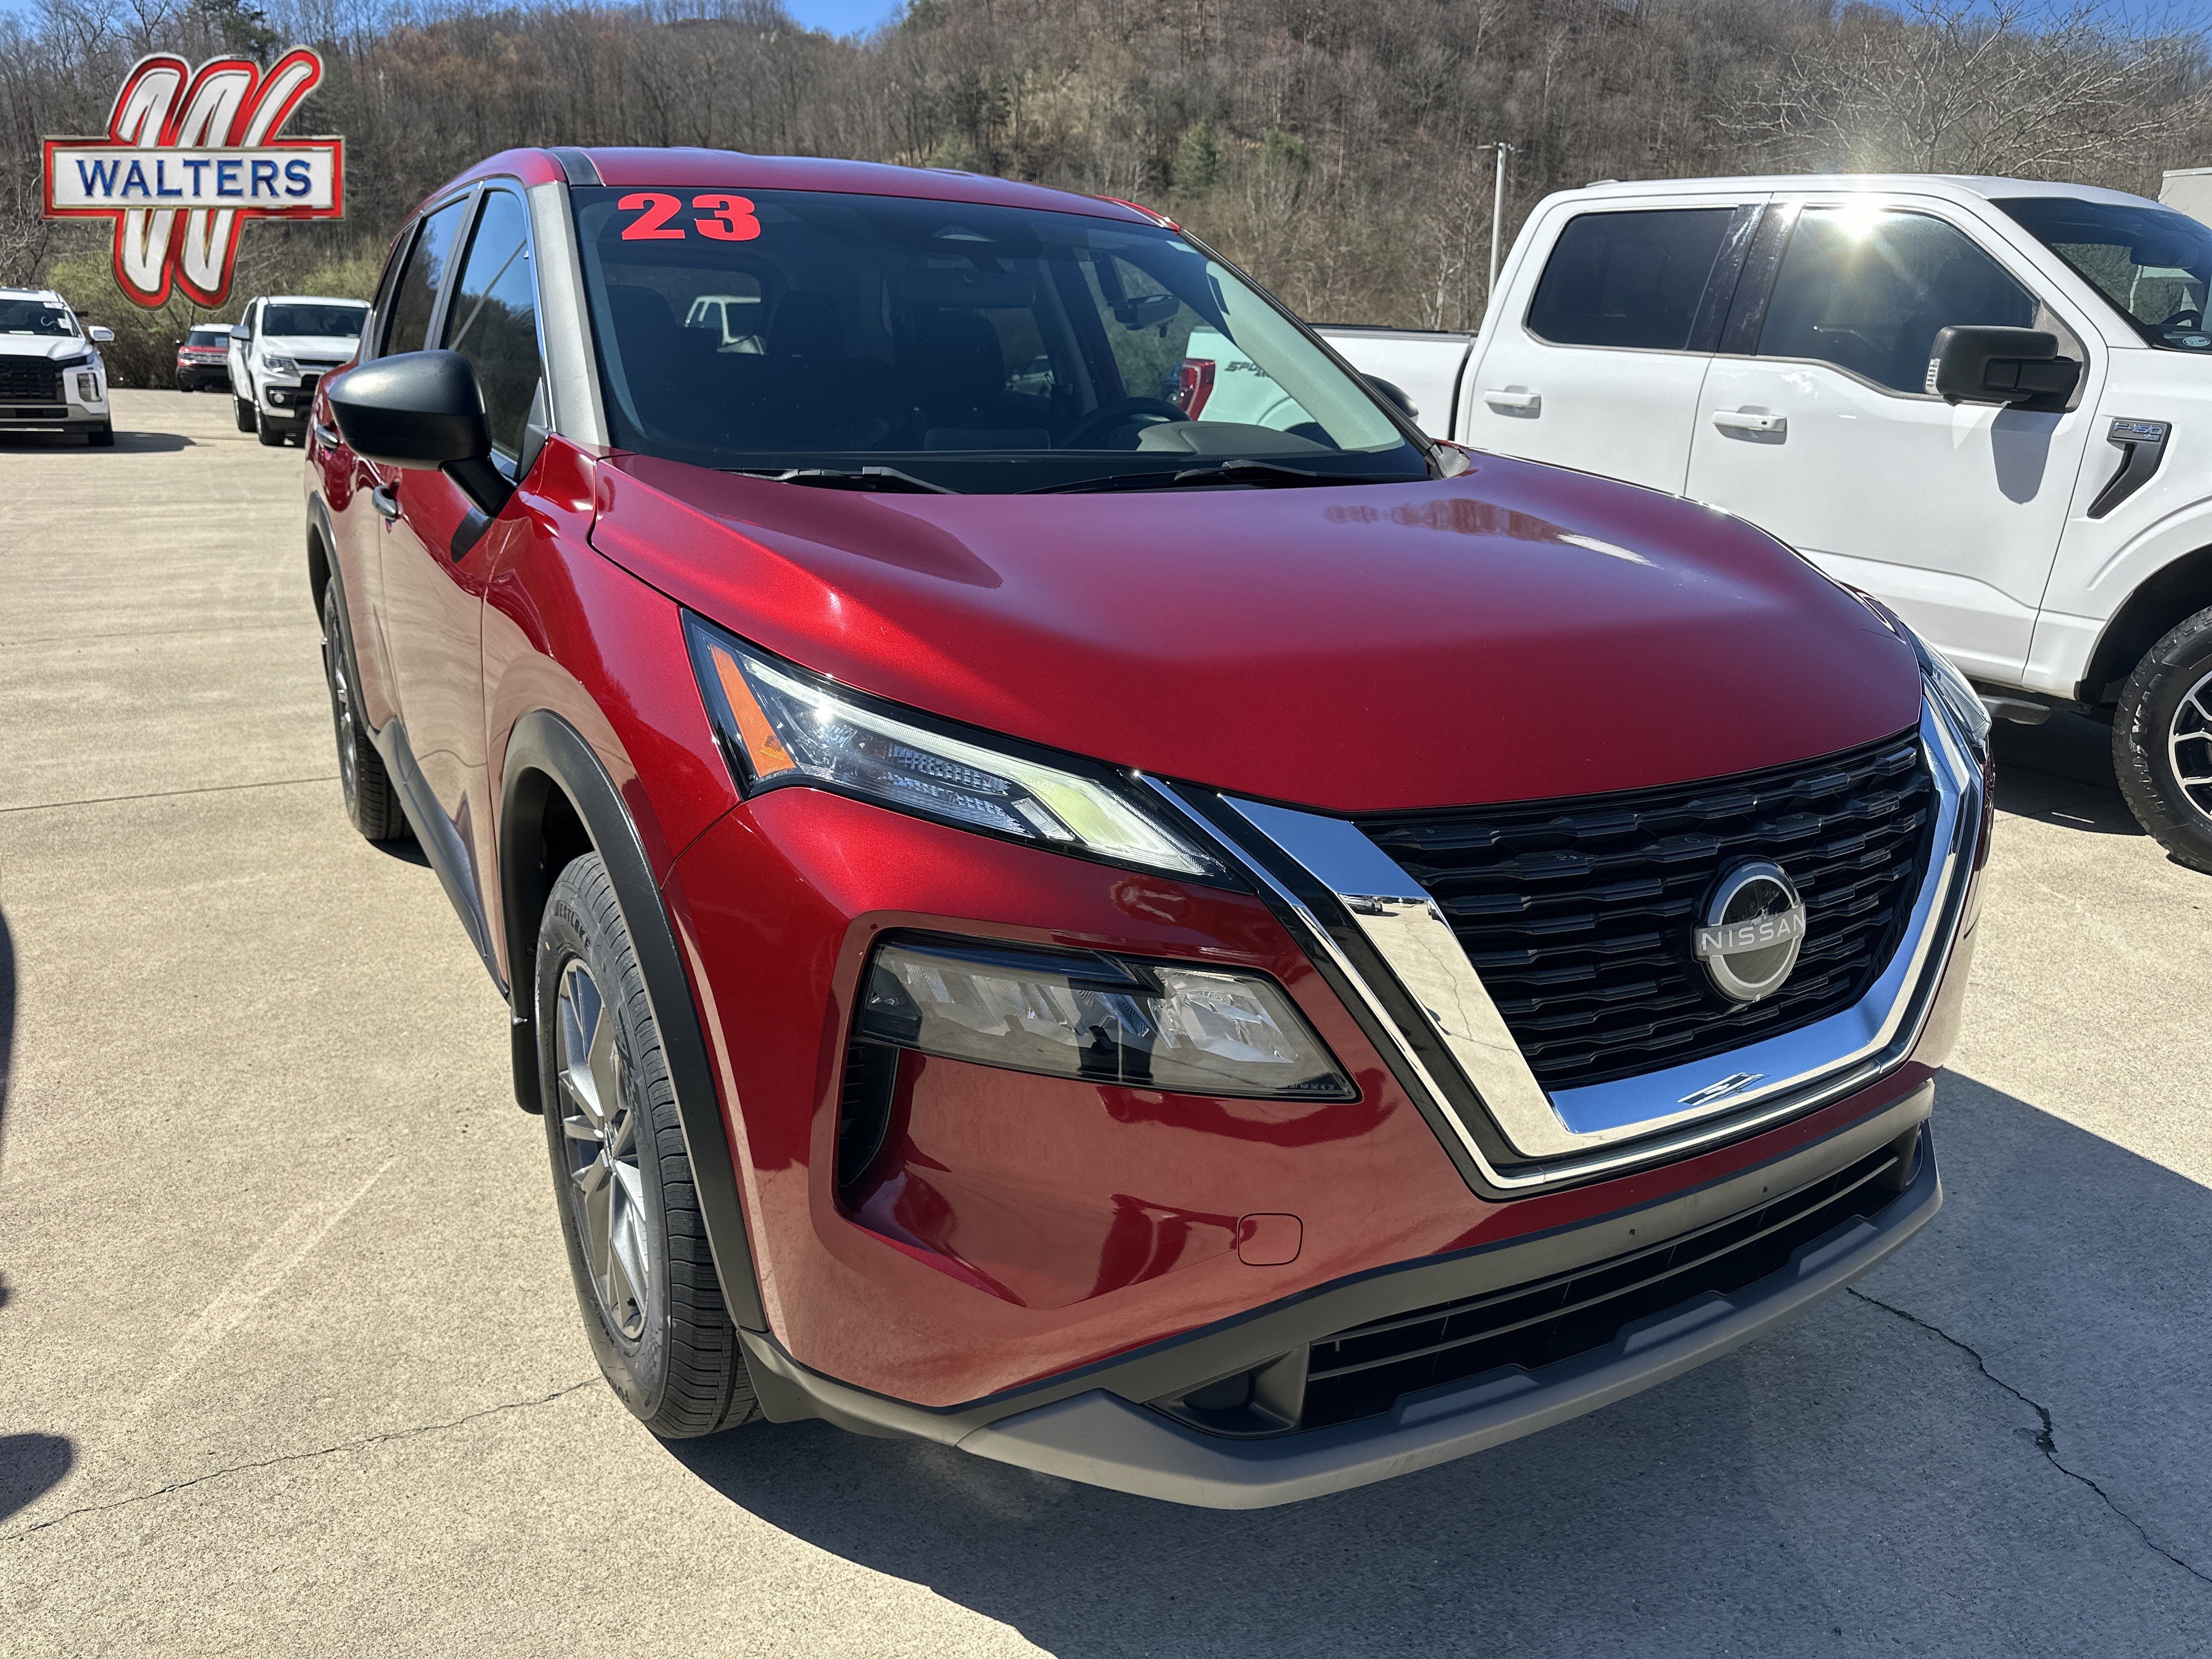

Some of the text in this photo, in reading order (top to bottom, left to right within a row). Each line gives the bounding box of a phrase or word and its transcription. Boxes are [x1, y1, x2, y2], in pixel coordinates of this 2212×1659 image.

[617, 193, 761, 241] 23
[1224, 361, 1259, 371] SPO
[2113, 422, 2163, 435] F-150
[1701, 913, 1805, 951] NISSAN
